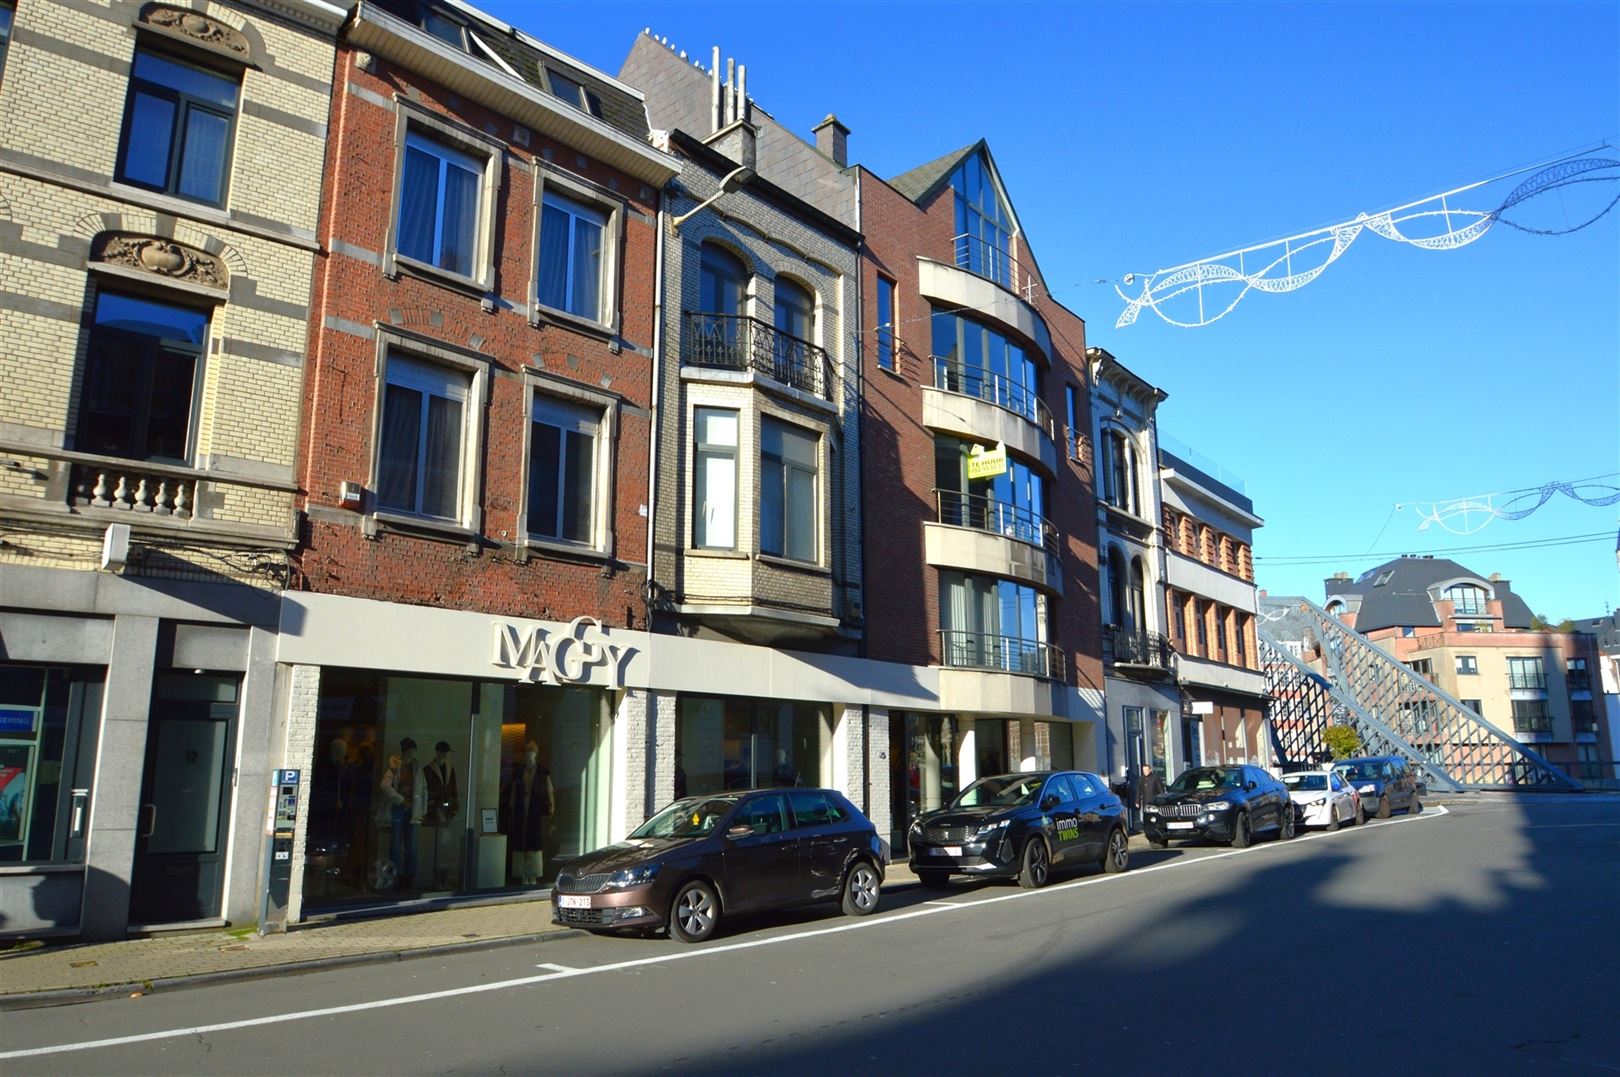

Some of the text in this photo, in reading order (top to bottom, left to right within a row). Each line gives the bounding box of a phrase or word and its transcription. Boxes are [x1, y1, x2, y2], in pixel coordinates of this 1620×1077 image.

[491, 615, 632, 690] MAGGY
[285, 770, 296, 781] P
[1056, 817, 1078, 831] immo
[1058, 827, 1079, 842] TWINS
